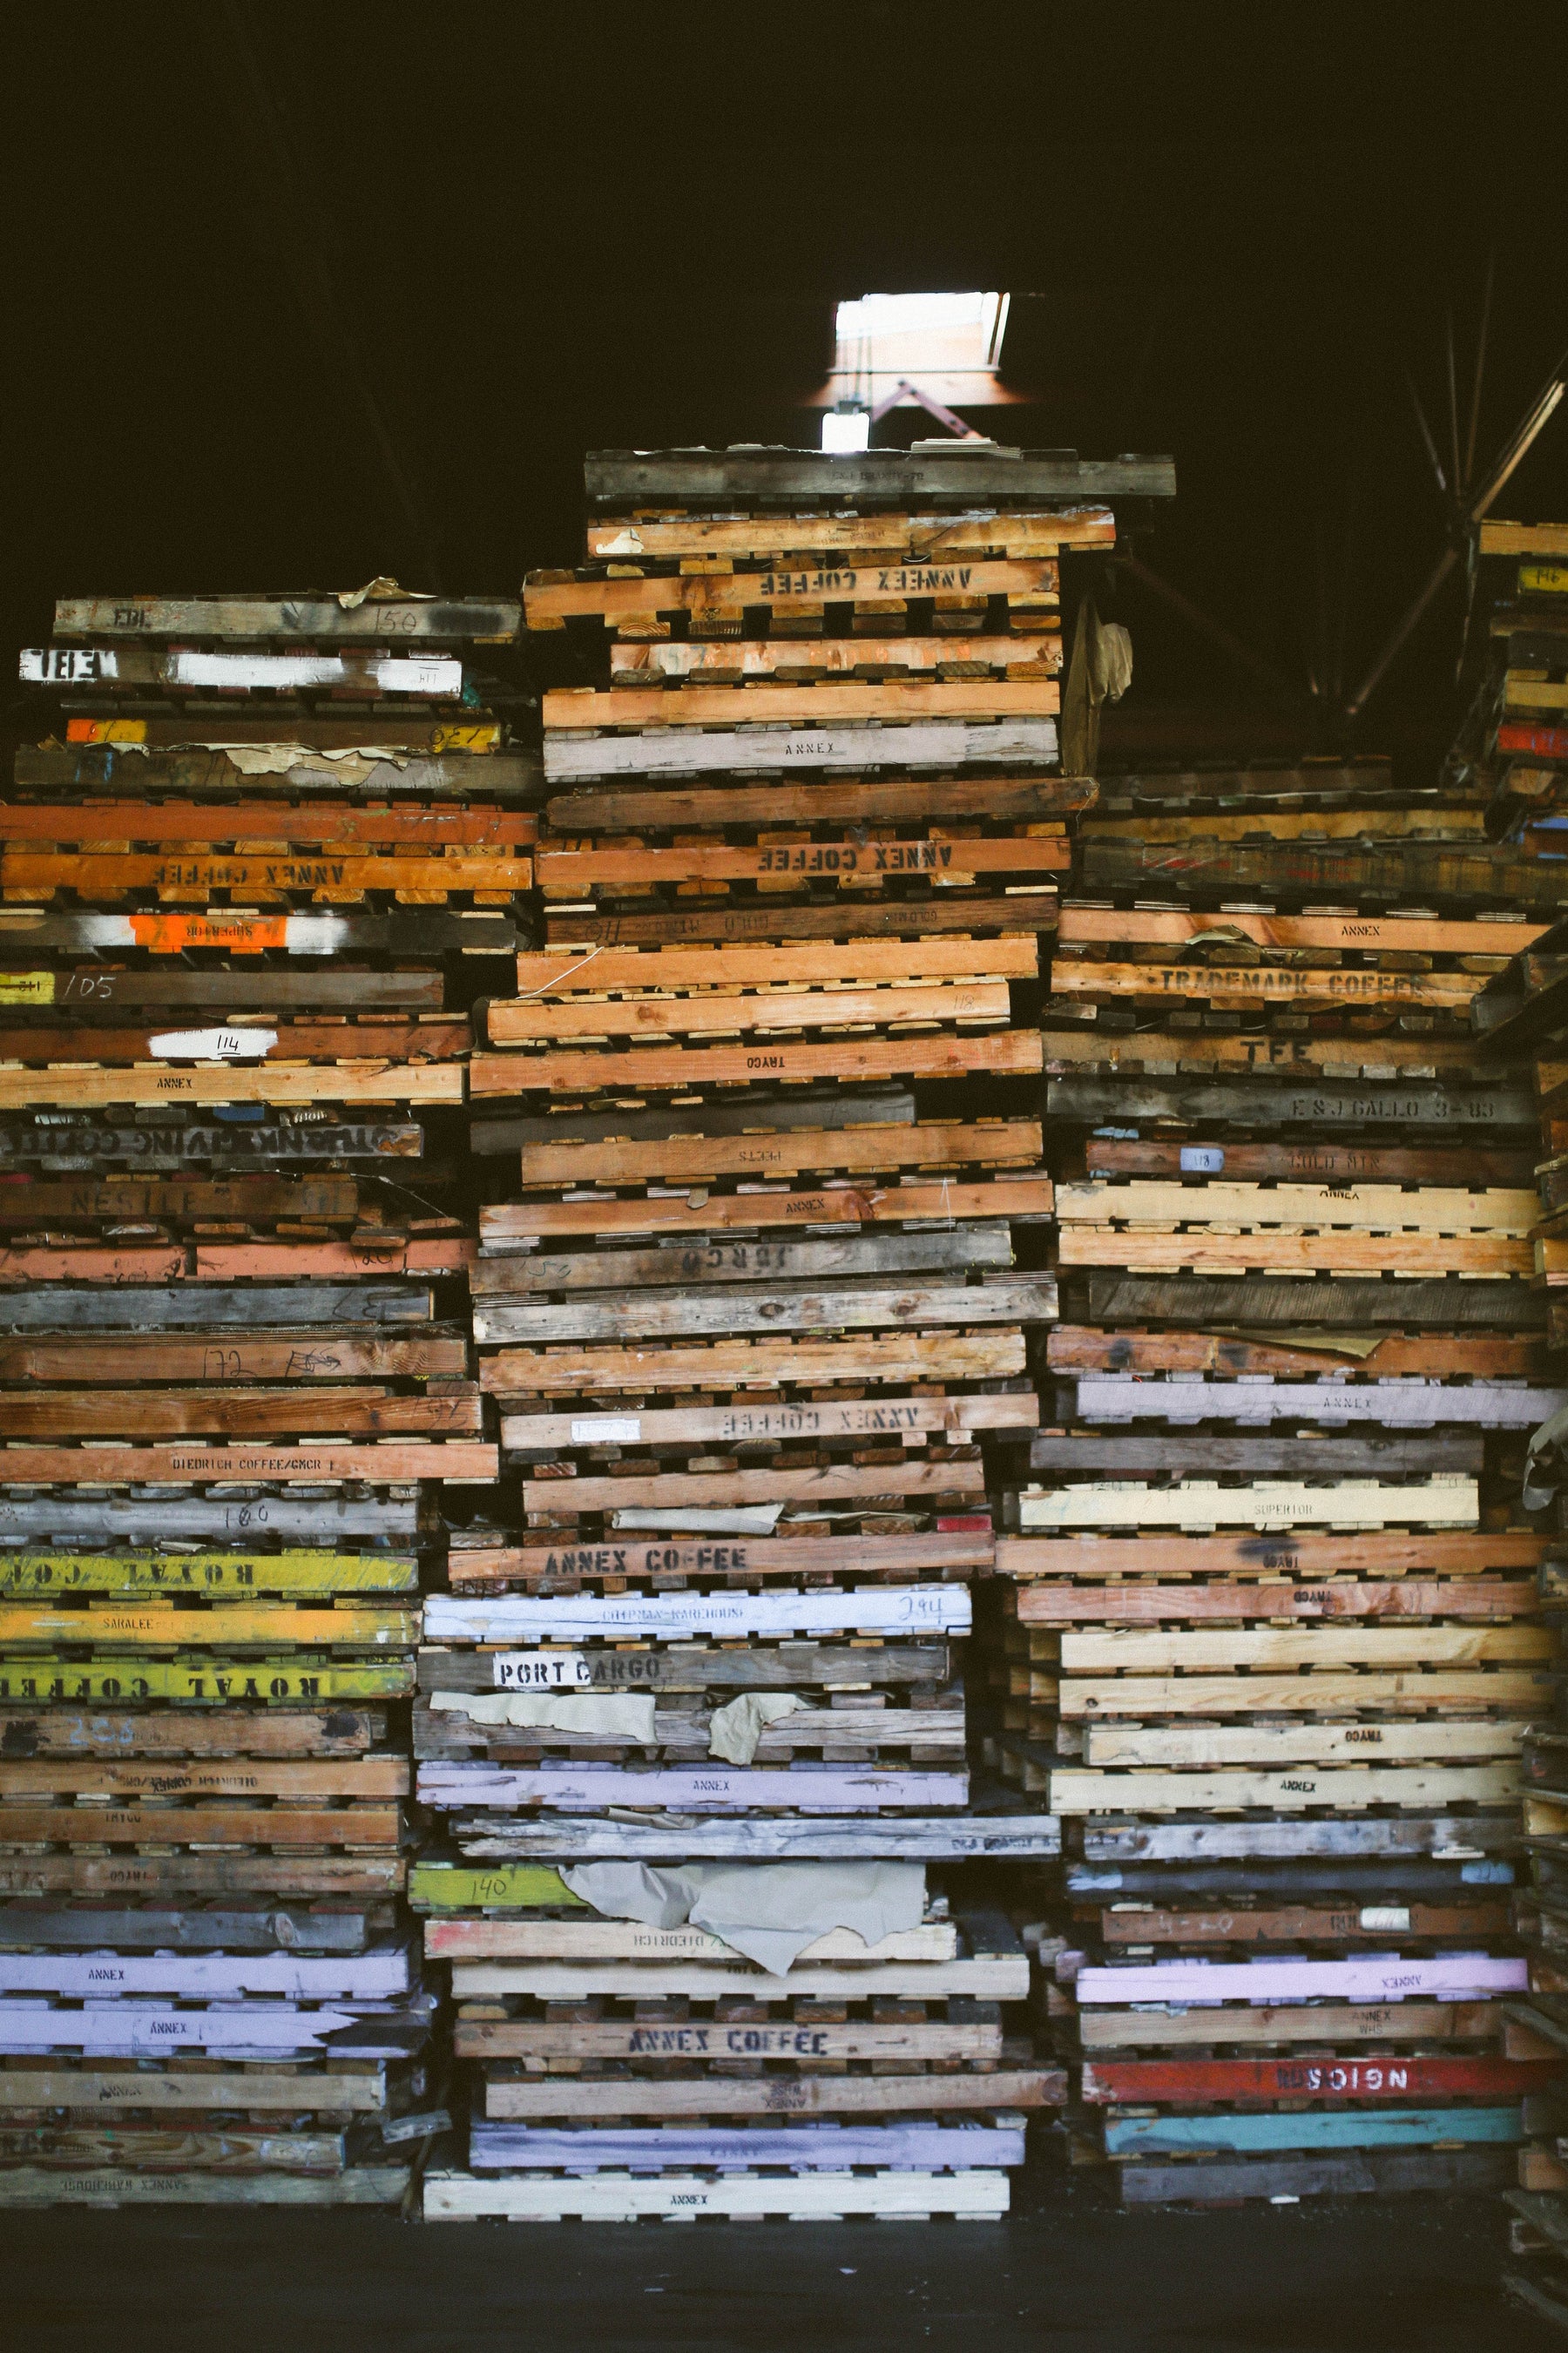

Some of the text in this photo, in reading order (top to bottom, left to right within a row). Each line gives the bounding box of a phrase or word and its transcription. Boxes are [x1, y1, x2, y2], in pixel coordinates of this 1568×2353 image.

[759, 571, 857, 596] COFFEE
[785, 742, 835, 755] ANNEX
[758, 847, 952, 870] ANNEX COFFEE
[152, 863, 344, 886] ANNEX COFFEE
[186, 926, 253, 937] SUPERIOR
[1342, 925, 1379, 936] ANNEX
[63, 975, 117, 997] 105
[1161, 971, 1423, 996] TRADEMARK COFFEE
[217, 1035, 240, 1051] 114
[747, 1057, 786, 1068] TRYCO
[157, 1078, 193, 1090] ANNEX
[1352, 1101, 1418, 1117] GALLO
[739, 1150, 782, 1162] PEETS
[785, 1198, 825, 1213] ANNEX
[203, 1348, 255, 1376] 172
[1324, 1397, 1371, 1409] ANNEX
[723, 1405, 918, 1435] ANNEX COFFEE
[172, 1459, 232, 1471] DIEDRICH
[239, 1458, 322, 1471] COFFEE/GMCR
[1254, 1504, 1312, 1516] SUPERIOR
[544, 1551, 626, 1574] ANNEX
[123, 1563, 255, 1584] ROYAL
[1294, 1591, 1333, 1604] TRYCO
[104, 1619, 153, 1630] SARALEE
[500, 1658, 660, 1684] PORT CARGO
[189, 1678, 320, 1699] ROYAL
[1345, 1729, 1382, 1742] TRYCO
[693, 1779, 731, 1792] ANNEX
[1280, 1780, 1316, 1793] ANNEX
[471, 1876, 507, 1898] 140
[633, 1935, 704, 1947] DIEDRICH
[88, 1969, 125, 1981] ANNEX
[1382, 1974, 1422, 1988] ANNEX
[151, 2021, 186, 2034] ANNEX
[629, 2031, 828, 2055] ANNEX COFFEE
[671, 2195, 708, 2206] ANNEX
